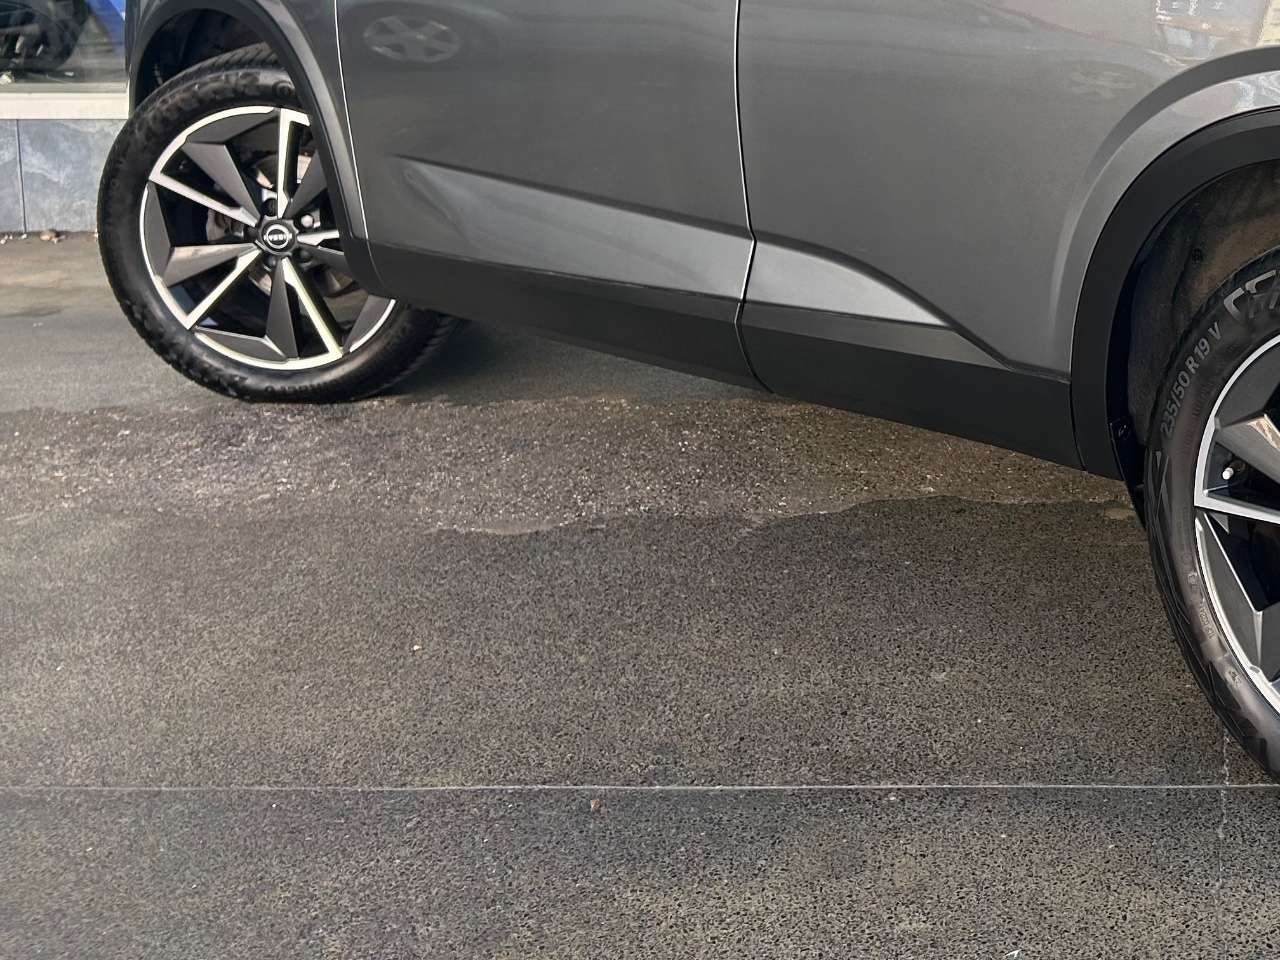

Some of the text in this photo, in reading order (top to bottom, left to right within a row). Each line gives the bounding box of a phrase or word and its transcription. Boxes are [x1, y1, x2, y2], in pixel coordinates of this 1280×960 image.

[1160, 370, 1191, 435] 235/50
[1184, 355, 1200, 375] R
[1193, 337, 1211, 360] 19
[1207, 321, 1221, 341] V
